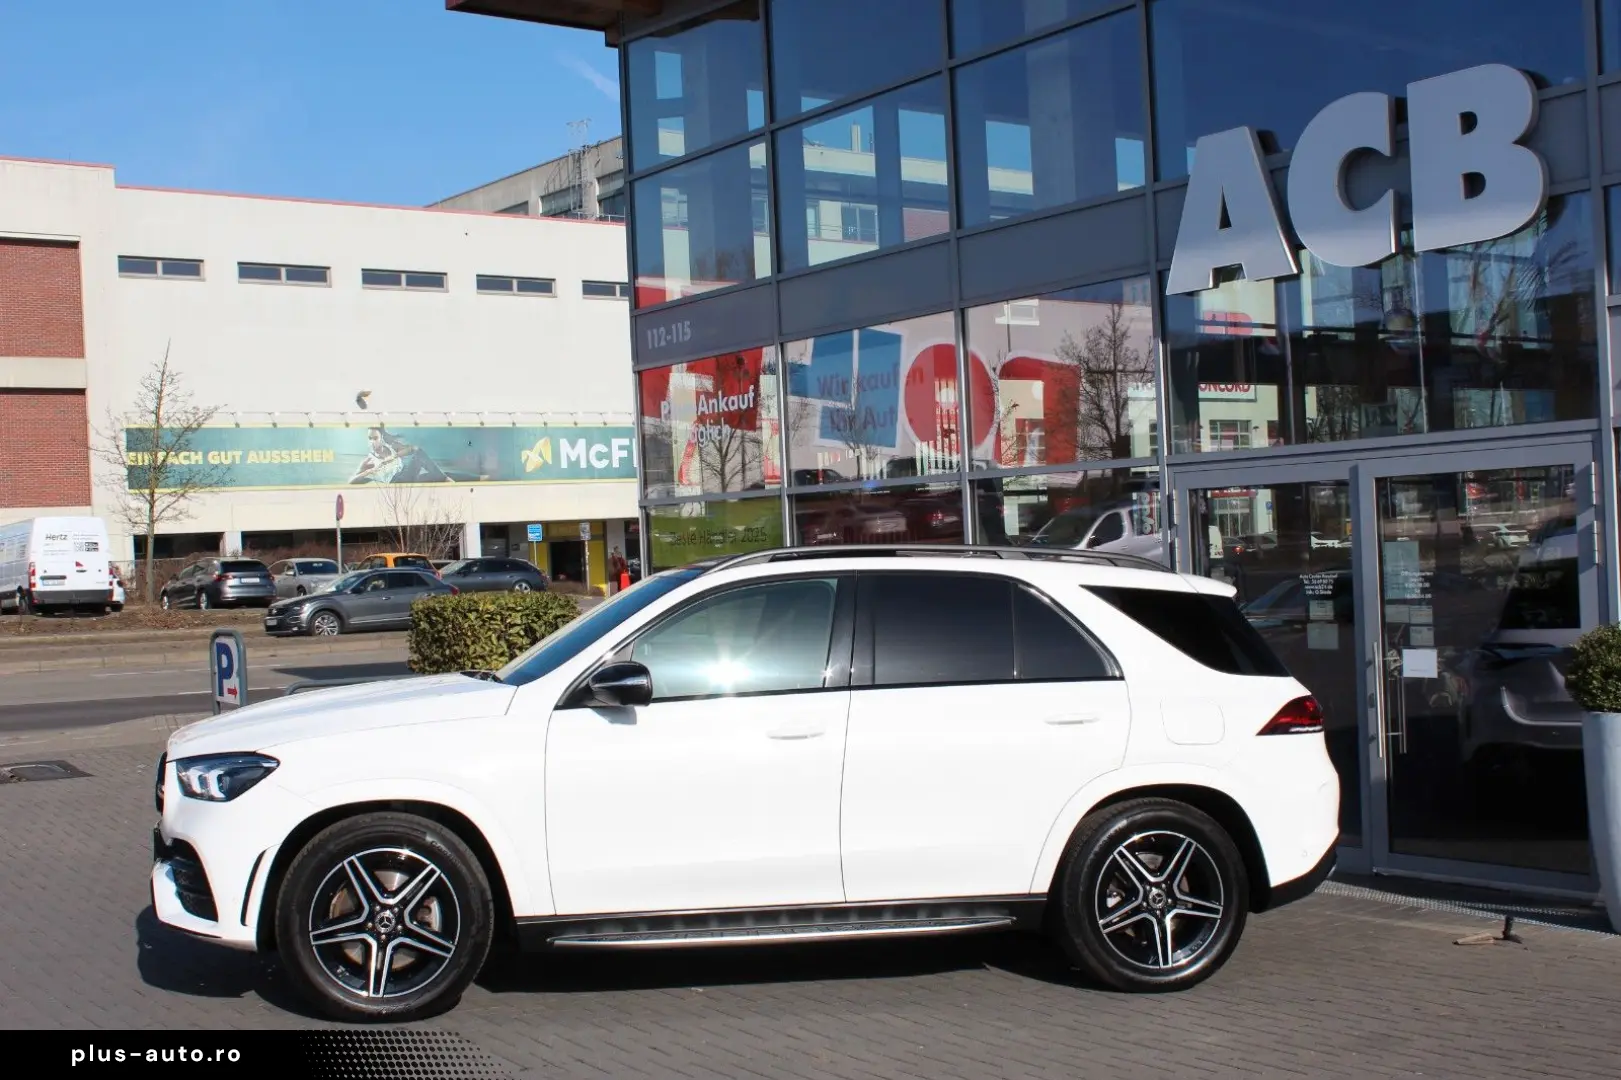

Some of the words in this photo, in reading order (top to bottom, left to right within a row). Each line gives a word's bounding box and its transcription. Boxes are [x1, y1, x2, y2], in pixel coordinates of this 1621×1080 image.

[1165, 62, 1549, 296] ACB
[647, 320, 692, 350] 112-115
[817, 371, 849, 398] Wir
[697, 384, 755, 415] Ankauf
[862, 404, 914, 432] Aut
[127, 451, 204, 466] EINFACH
[207, 450, 243, 465] GUT
[246, 449, 336, 464] AUSSEHEN
[45, 533, 69, 541] Hertz
[215, 641, 235, 698] P
